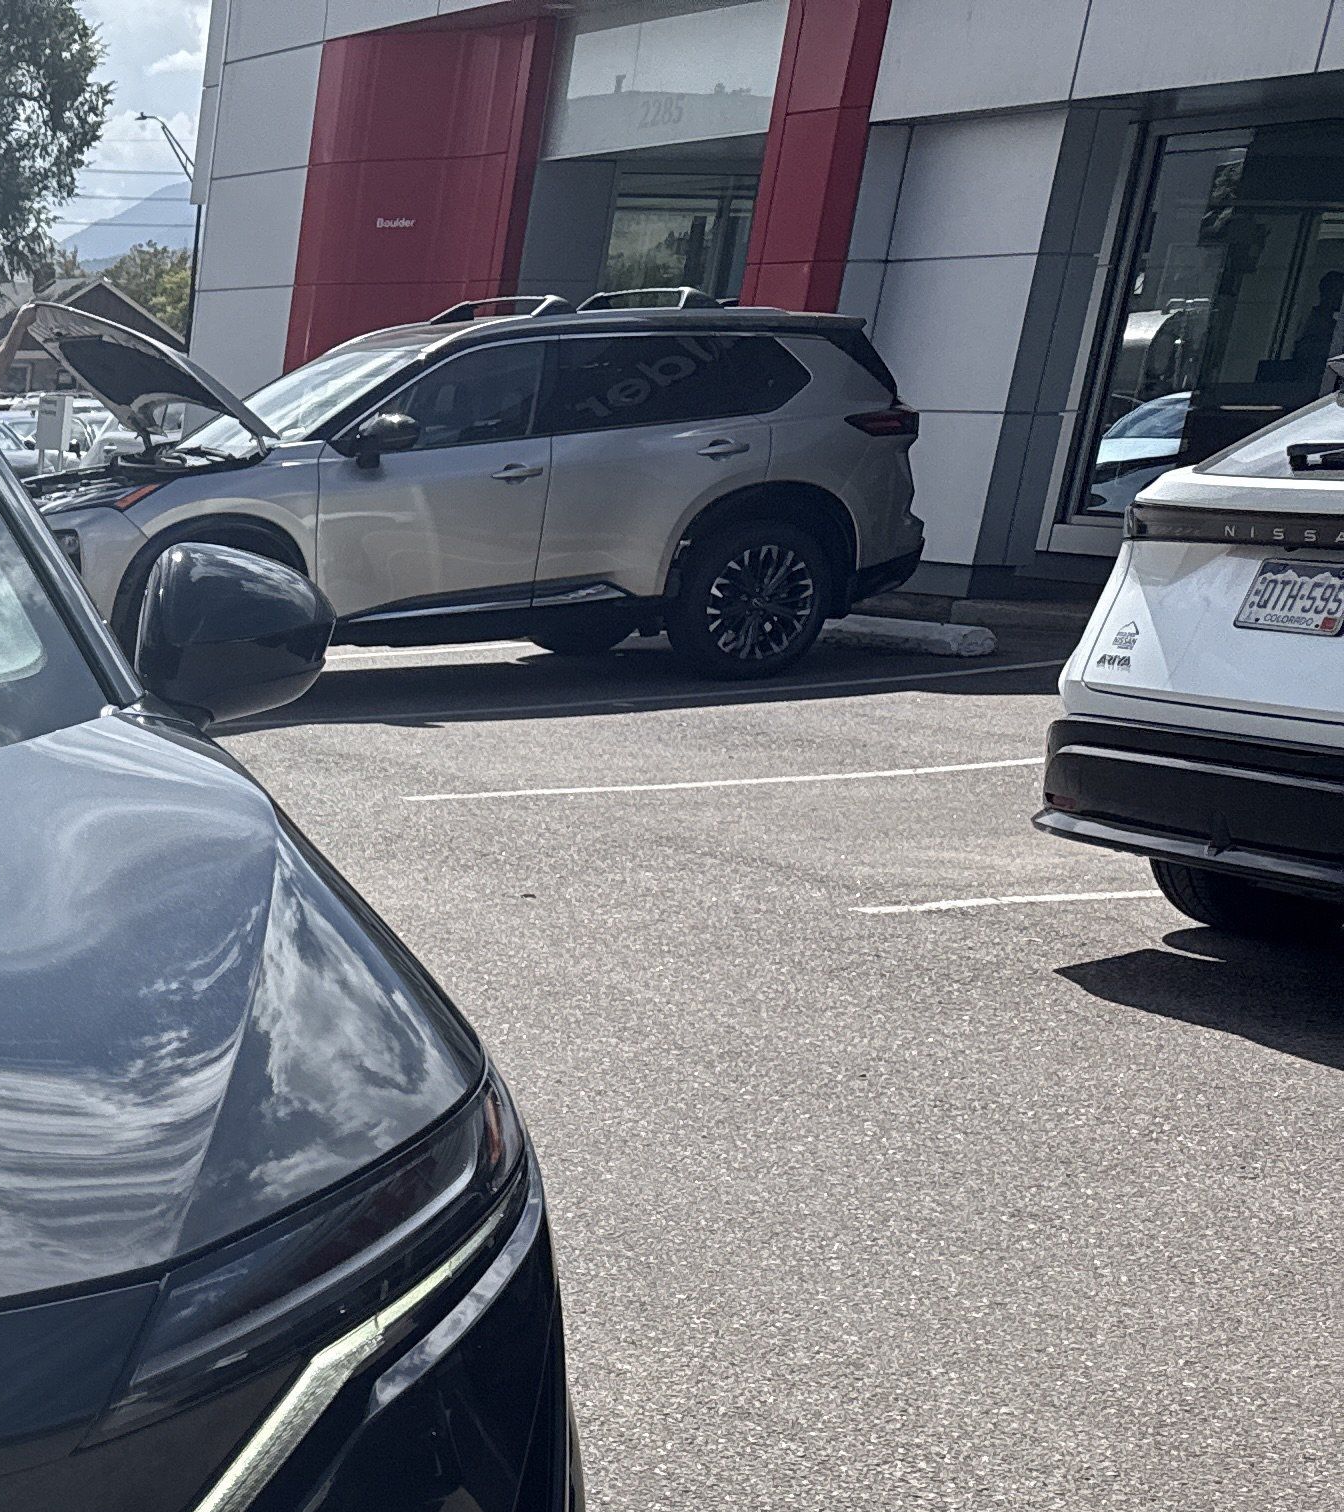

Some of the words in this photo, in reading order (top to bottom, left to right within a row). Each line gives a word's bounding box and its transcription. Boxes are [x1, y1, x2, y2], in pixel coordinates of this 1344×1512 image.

[638, 95, 684, 128] 2285
[377, 218, 416, 228] Boulder
[1224, 525, 1344, 542] NISSA
[1263, 612, 1314, 627] COLORADO
[1096, 654, 1131, 666] ARIYA
